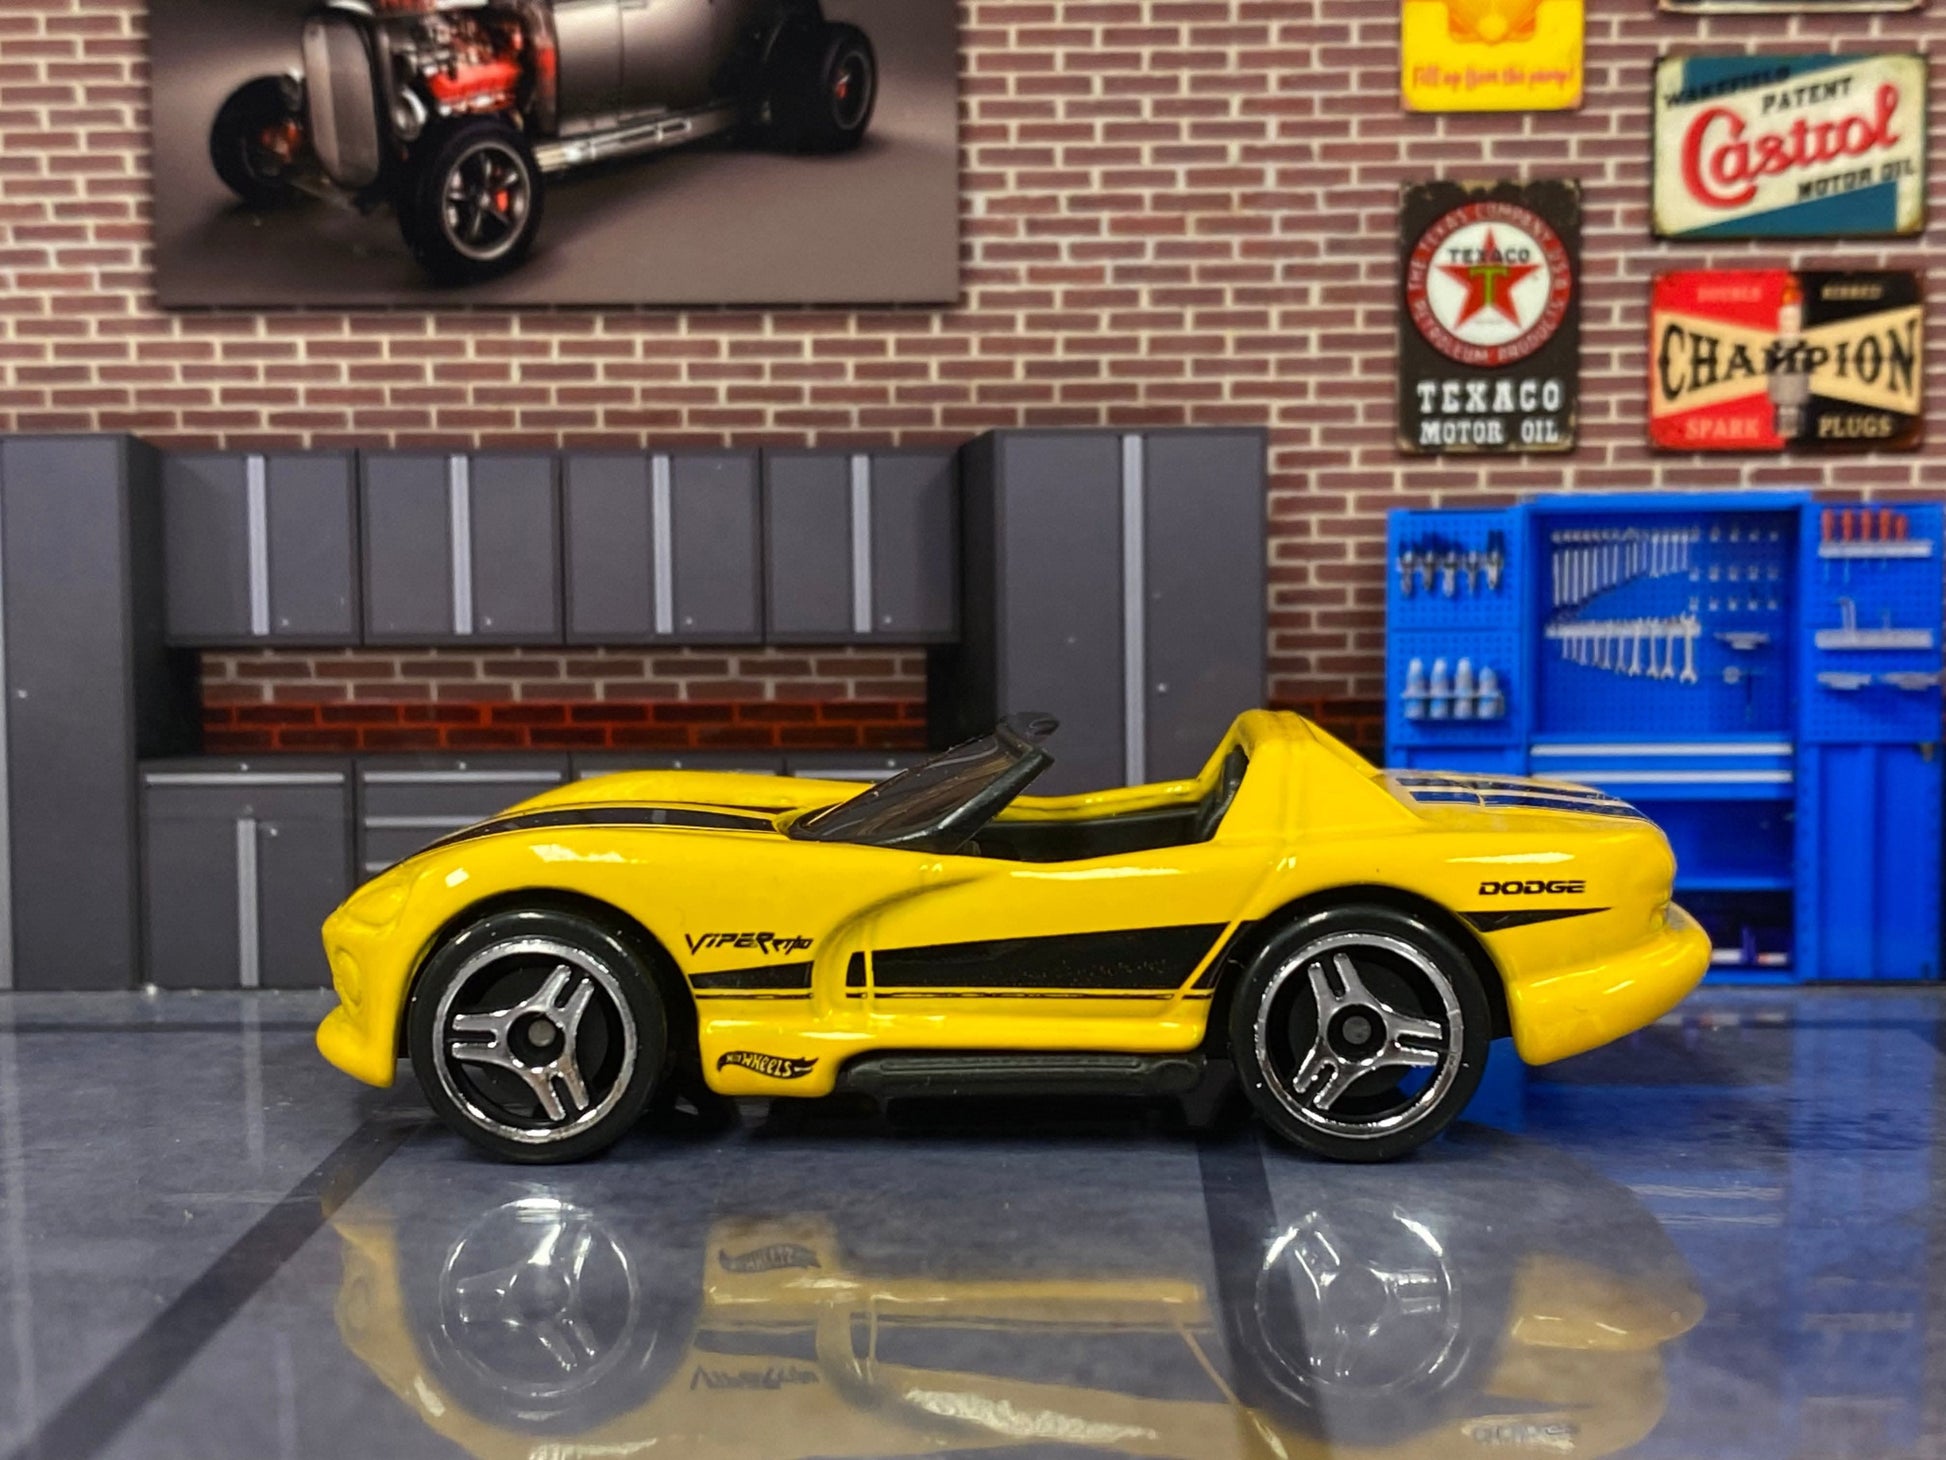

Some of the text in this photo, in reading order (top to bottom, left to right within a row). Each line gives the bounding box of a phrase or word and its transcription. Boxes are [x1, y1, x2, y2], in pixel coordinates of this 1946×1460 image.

[1762, 77, 1852, 114] PATENT
[1681, 82, 1901, 209] Castrol
[1798, 159, 1915, 199] MOTOR OIL
[1448, 248, 1531, 263] TEXACO
[1659, 317, 1918, 401] CHAMPION
[1417, 381, 1561, 413] TEXACO
[1419, 419, 1559, 445] MOTOR OIL
[1684, 415, 1893, 439] SPARK PLUGS
[1478, 880, 1586, 896] DODGE
[685, 932, 775, 955] VIPER
[742, 1052, 793, 1078] WHEELS
